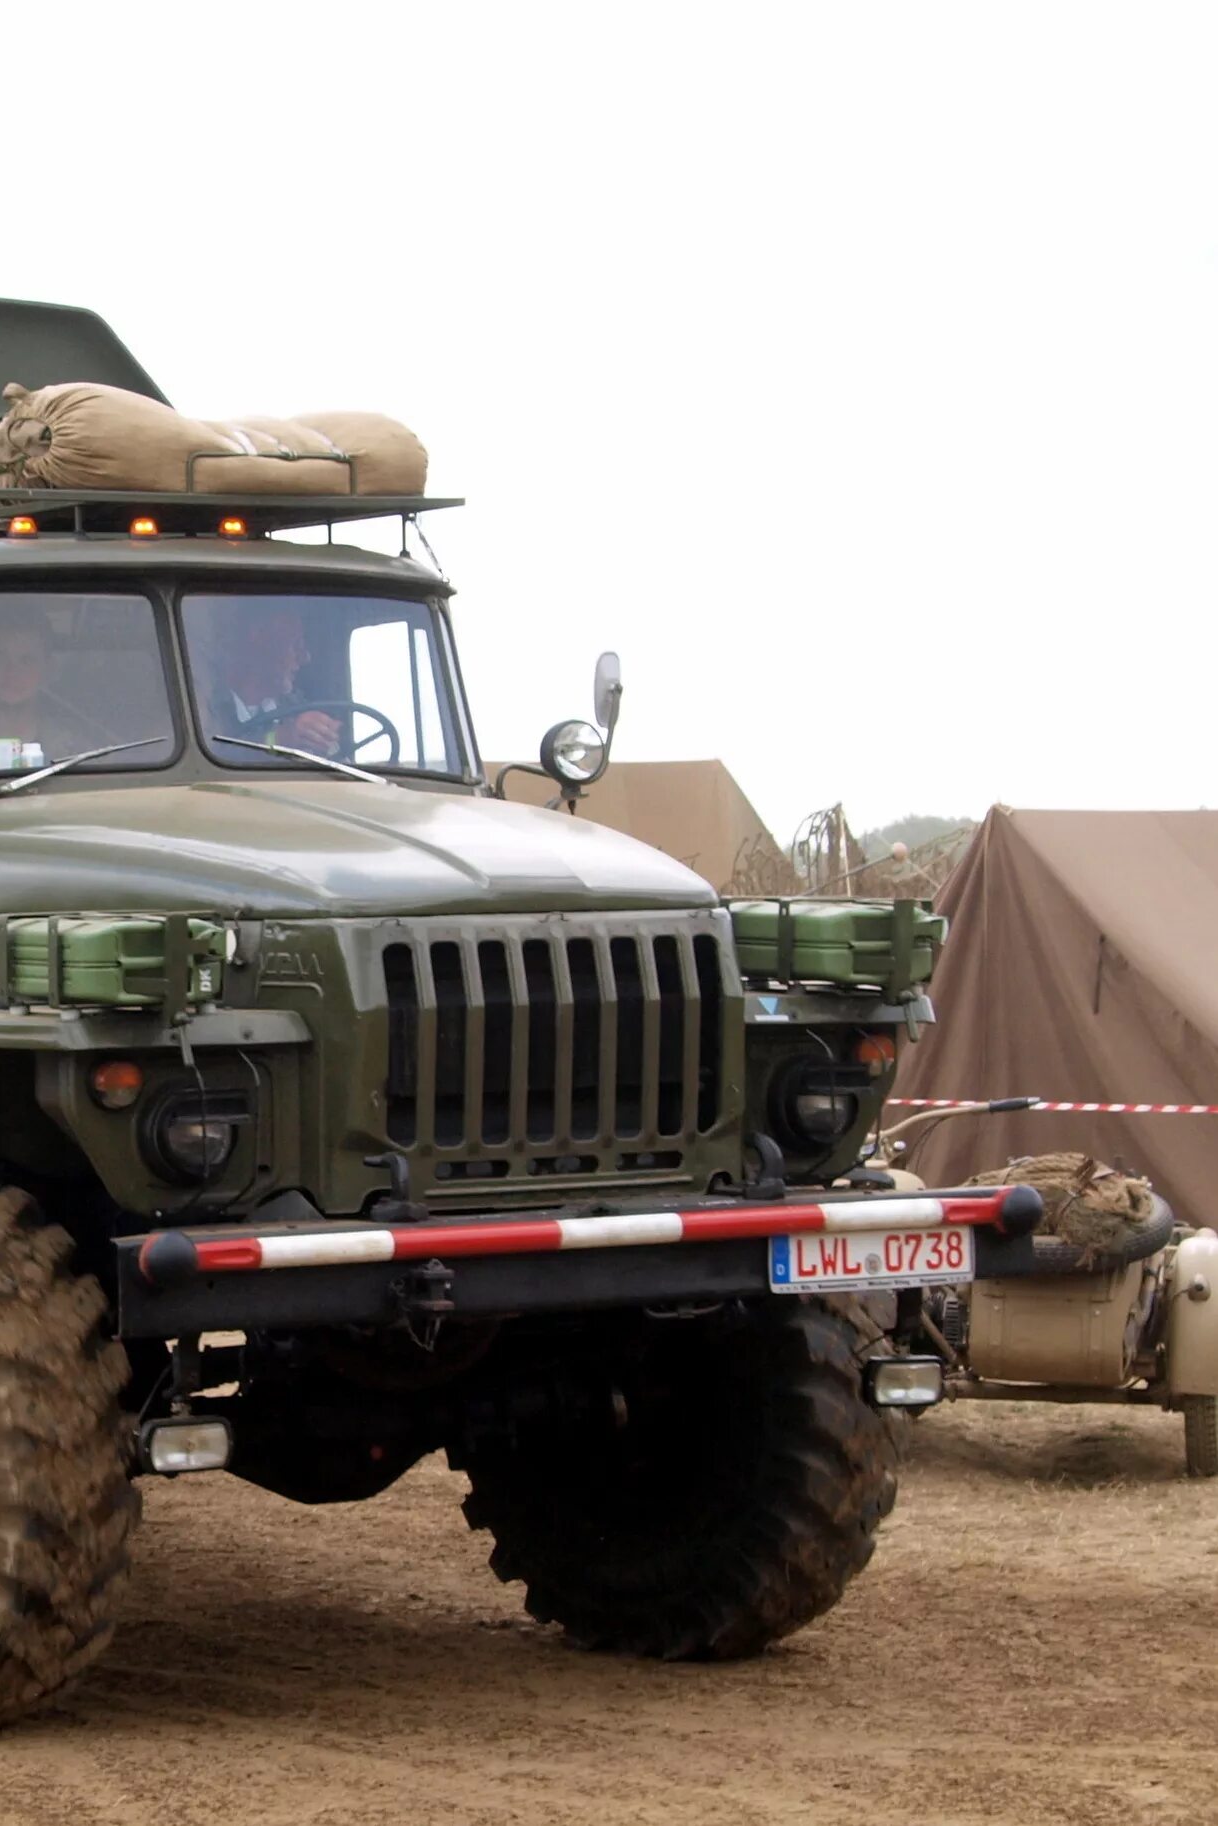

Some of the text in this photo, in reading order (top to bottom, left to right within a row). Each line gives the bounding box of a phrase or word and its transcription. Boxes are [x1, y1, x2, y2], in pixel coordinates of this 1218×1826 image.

[200, 969, 212, 992] DK
[797, 1238, 861, 1277] LWL
[884, 1231, 963, 1272] 0738
